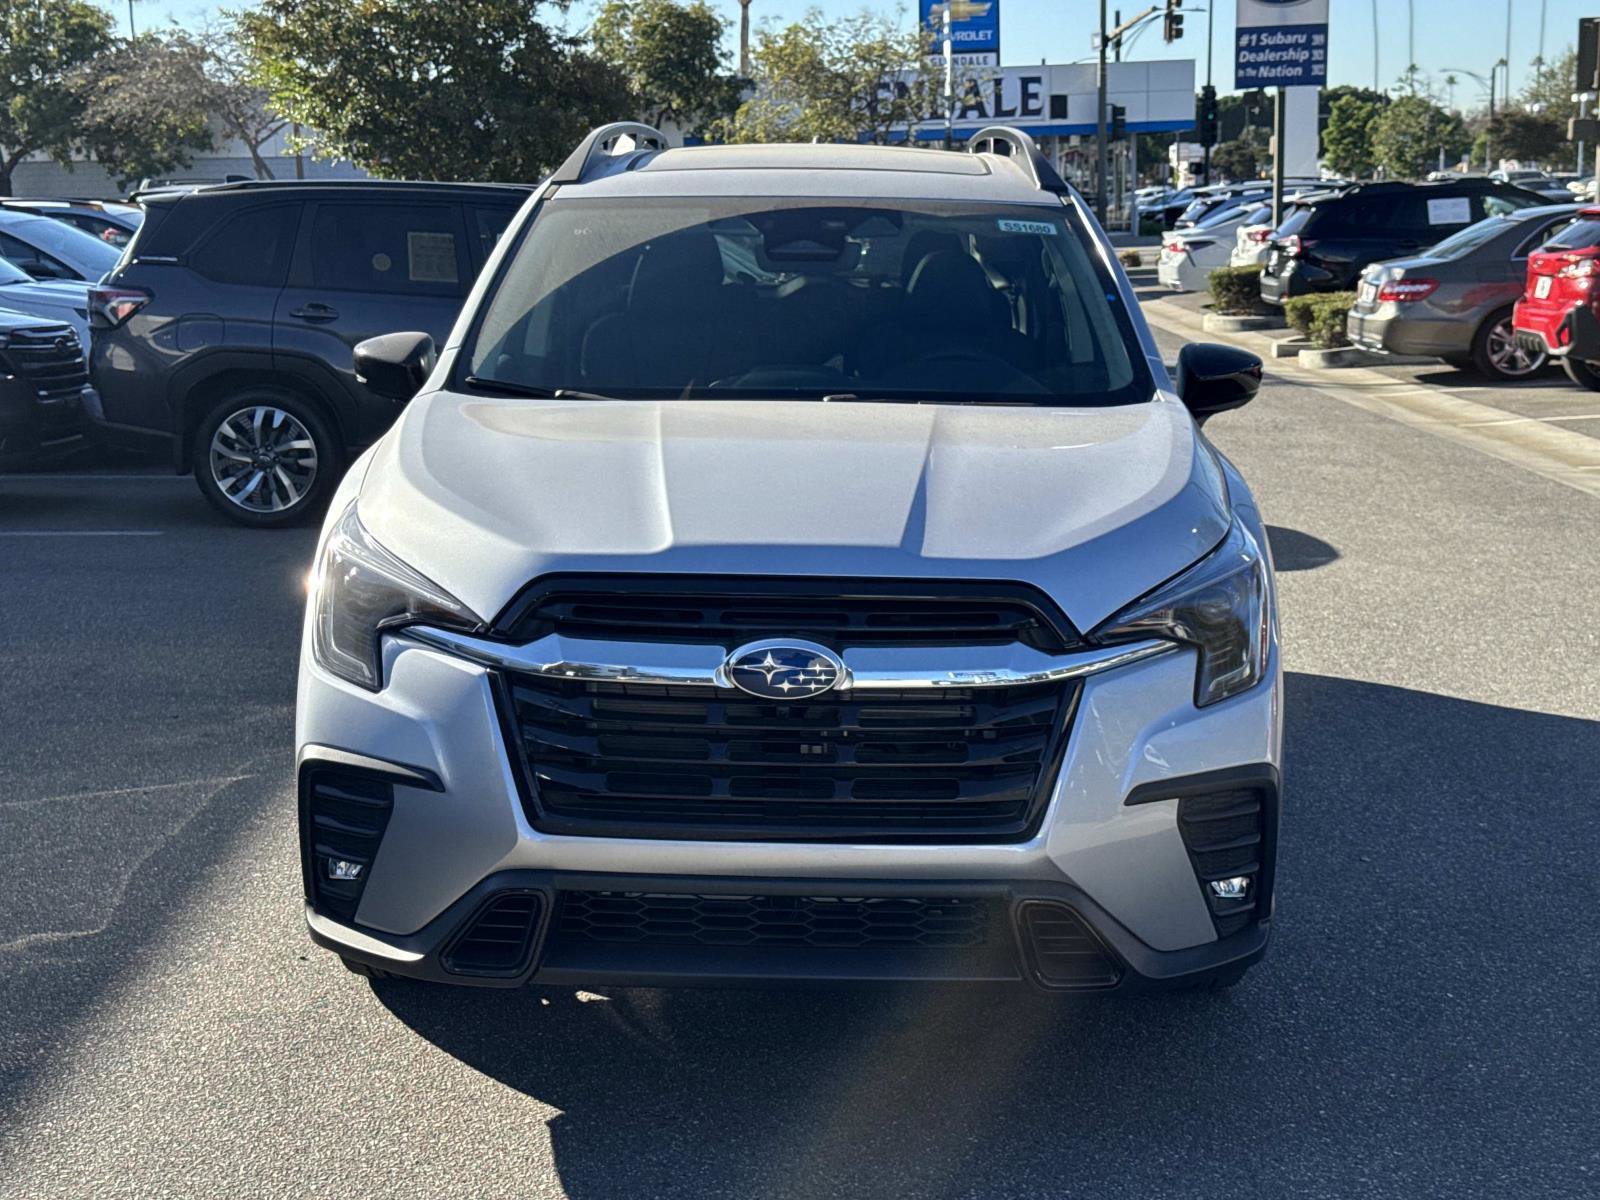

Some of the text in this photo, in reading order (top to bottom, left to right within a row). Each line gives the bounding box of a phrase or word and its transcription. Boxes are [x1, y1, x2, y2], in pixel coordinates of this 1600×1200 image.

[1239, 33, 1257, 47] #1
[1259, 32, 1307, 46] Subaru
[930, 55, 989, 67] GLNDALE
[1239, 48, 1309, 62] Dealership
[1258, 64, 1303, 78] Nation
